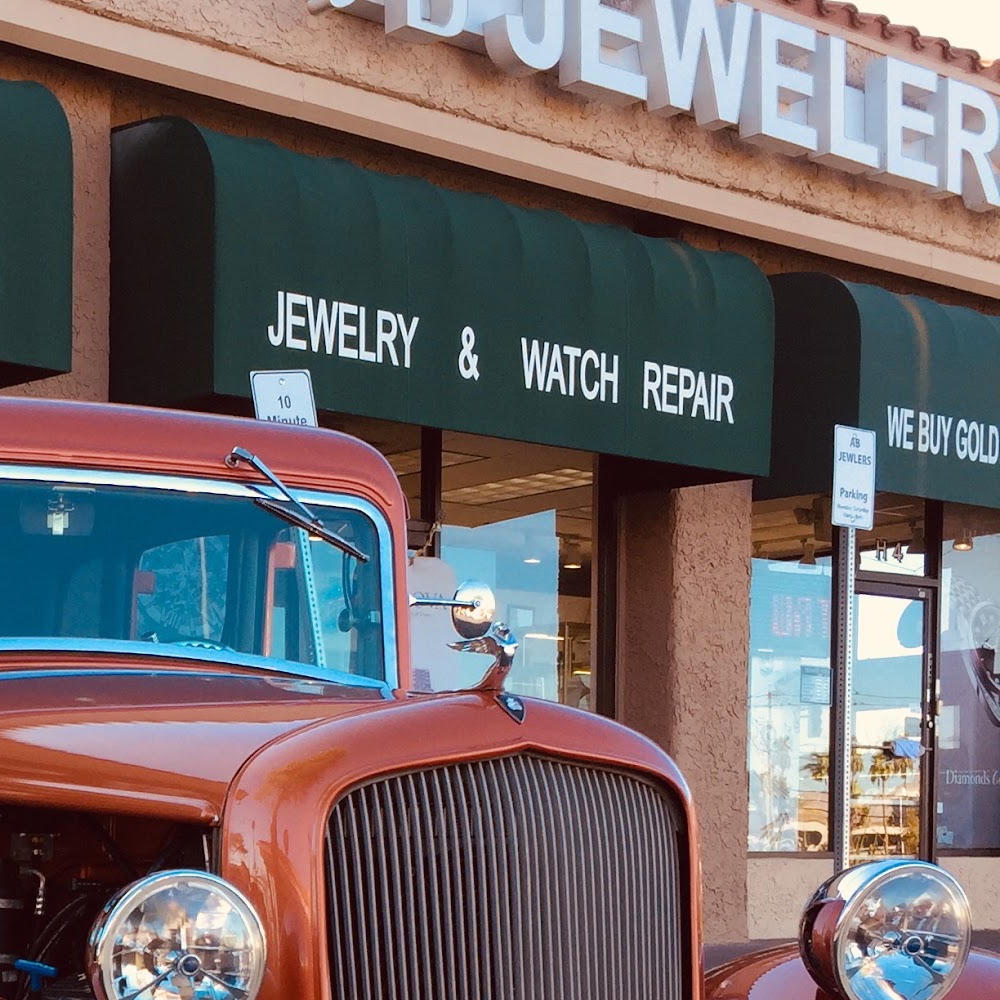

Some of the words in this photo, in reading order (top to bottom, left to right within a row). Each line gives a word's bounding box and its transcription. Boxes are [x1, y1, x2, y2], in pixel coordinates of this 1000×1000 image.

[267, 290, 420, 369] JEWELRY
[458, 325, 480, 382] &
[520, 337, 620, 404] WATCH
[643, 360, 735, 425] REPAIR
[277, 395, 292, 409] 10
[887, 405, 915, 451] WE
[918, 411, 954, 457] BUY
[955, 418, 1000, 465] GOLD
[838, 452, 872, 466] JEWLERS
[839, 487, 869, 504] Parking
[945, 769, 991, 785] Diamonds
